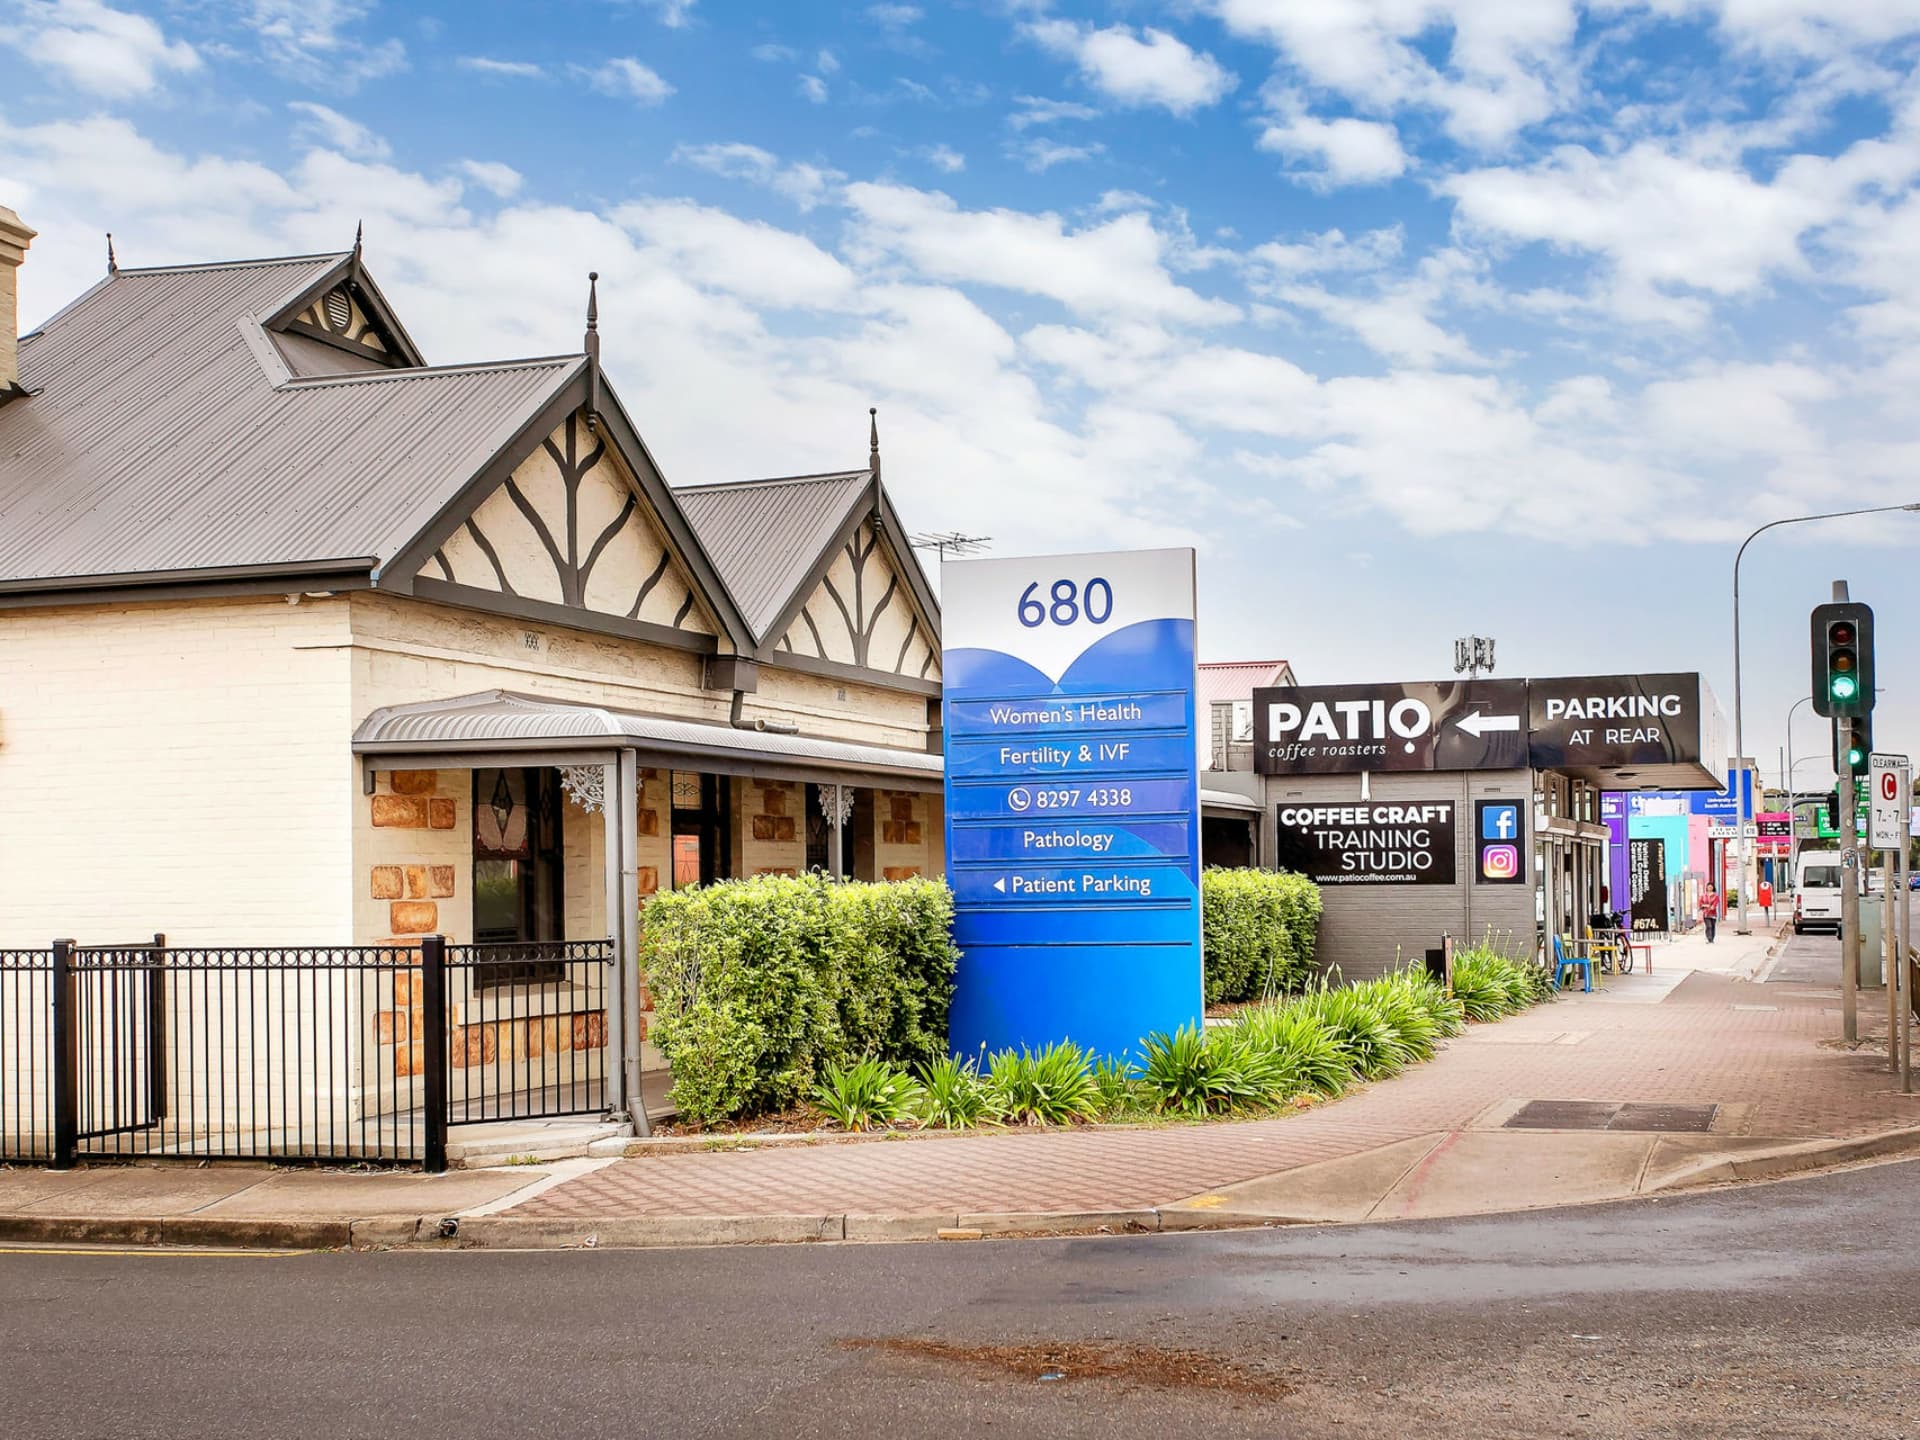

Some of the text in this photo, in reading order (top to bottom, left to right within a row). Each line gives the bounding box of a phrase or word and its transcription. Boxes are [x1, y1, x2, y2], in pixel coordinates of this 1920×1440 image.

[1018, 577, 1113, 627] 680
[990, 703, 1142, 725] Women's Health
[1546, 694, 1681, 720] PARKING
[1268, 698, 1431, 742] PATIO
[1569, 727, 1660, 745] AT REAR
[1001, 743, 1130, 768] Fertility & IVF
[1268, 743, 1387, 761] coffee roasters
[1036, 789, 1132, 808] 8297 4338
[1281, 805, 1451, 827] COFFEE CRAFT
[1024, 830, 1114, 851] Pathology
[1313, 829, 1430, 849] TRAINING
[1341, 851, 1433, 871] STUDIO
[1012, 874, 1151, 896] Patient Parking
[1315, 873, 1417, 883] www.patiocoffee.com.au
